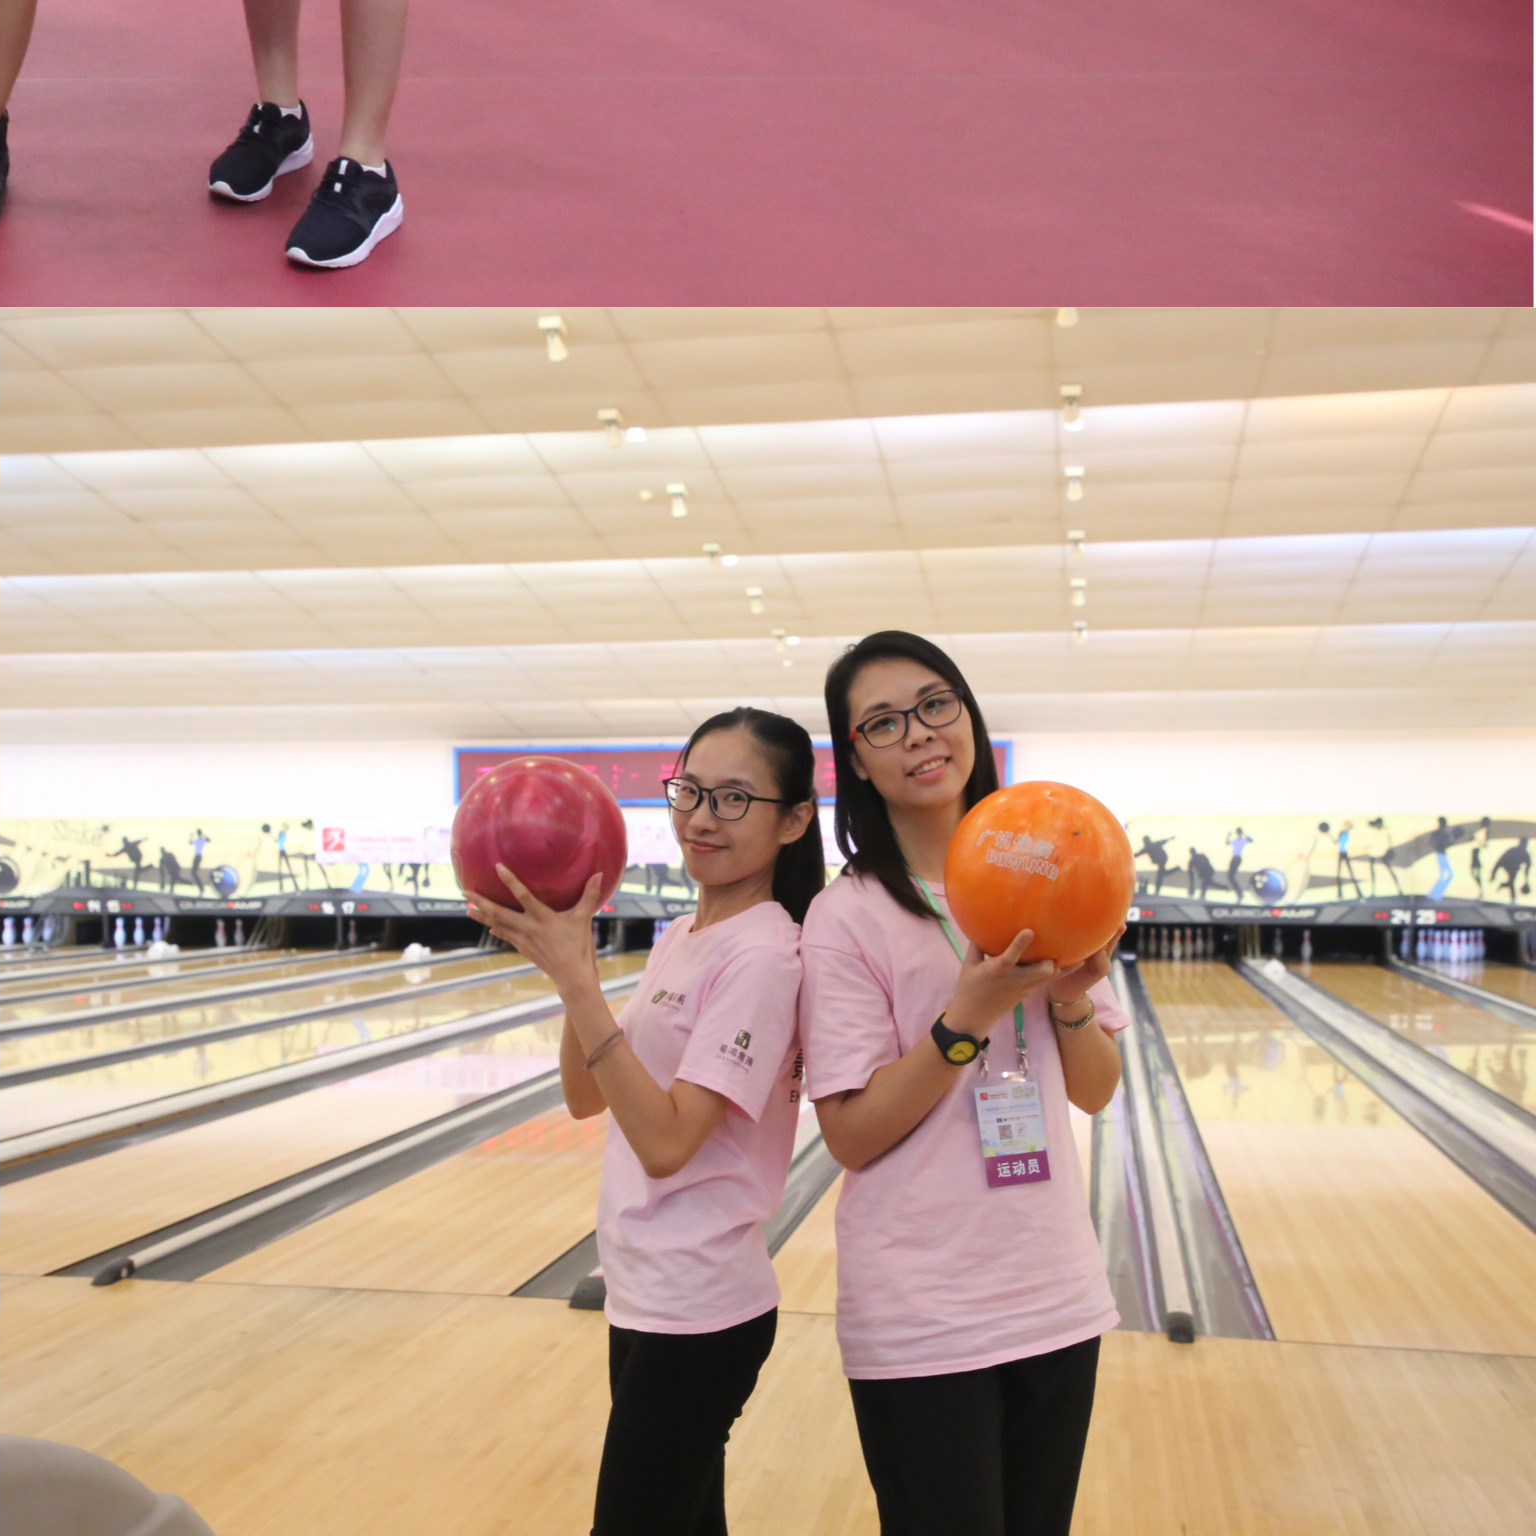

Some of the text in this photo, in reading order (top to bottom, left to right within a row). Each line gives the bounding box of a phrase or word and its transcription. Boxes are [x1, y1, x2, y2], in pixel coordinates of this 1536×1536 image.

[985, 848, 1060, 881] BOWLING
[997, 1158, 1041, 1178] 运动员
